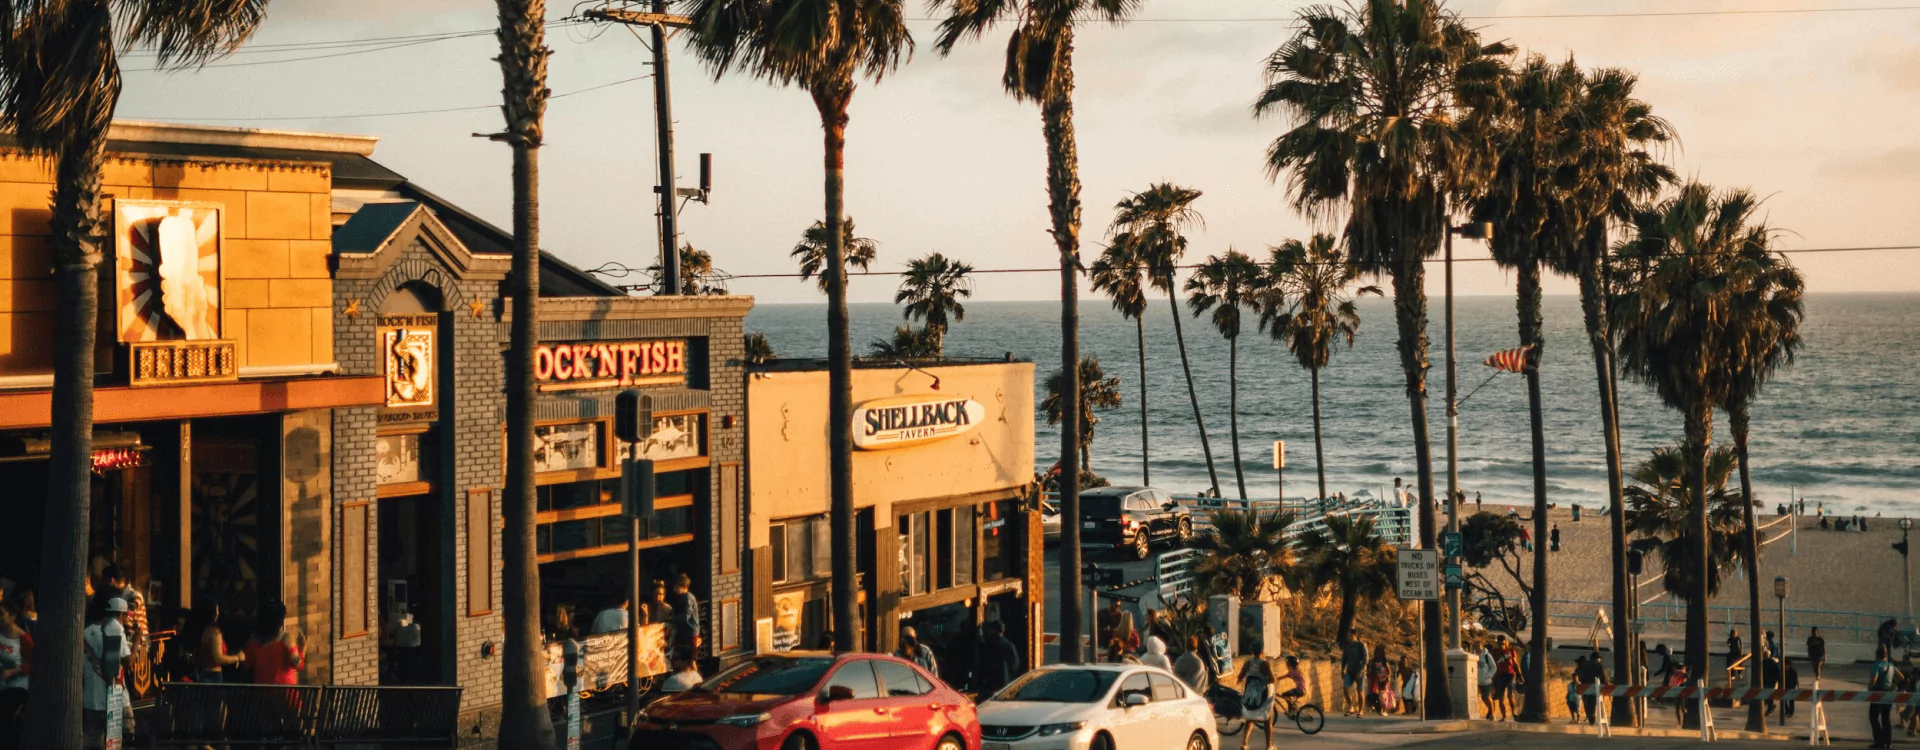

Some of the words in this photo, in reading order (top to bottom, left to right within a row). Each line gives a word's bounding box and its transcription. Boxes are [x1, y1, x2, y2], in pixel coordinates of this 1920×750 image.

[416, 315, 437, 326] FISH
[140, 346, 234, 379] BREWCO
[865, 400, 970, 436] SHELLBACK
[900, 427, 936, 440] TAVERN
[1411, 552, 1423, 560] NO
[1400, 562, 1424, 570] TRUCKS
[1426, 562, 1435, 570] OR
[1407, 571, 1428, 579] BUSES
[1402, 589, 1422, 597] OCEAN
